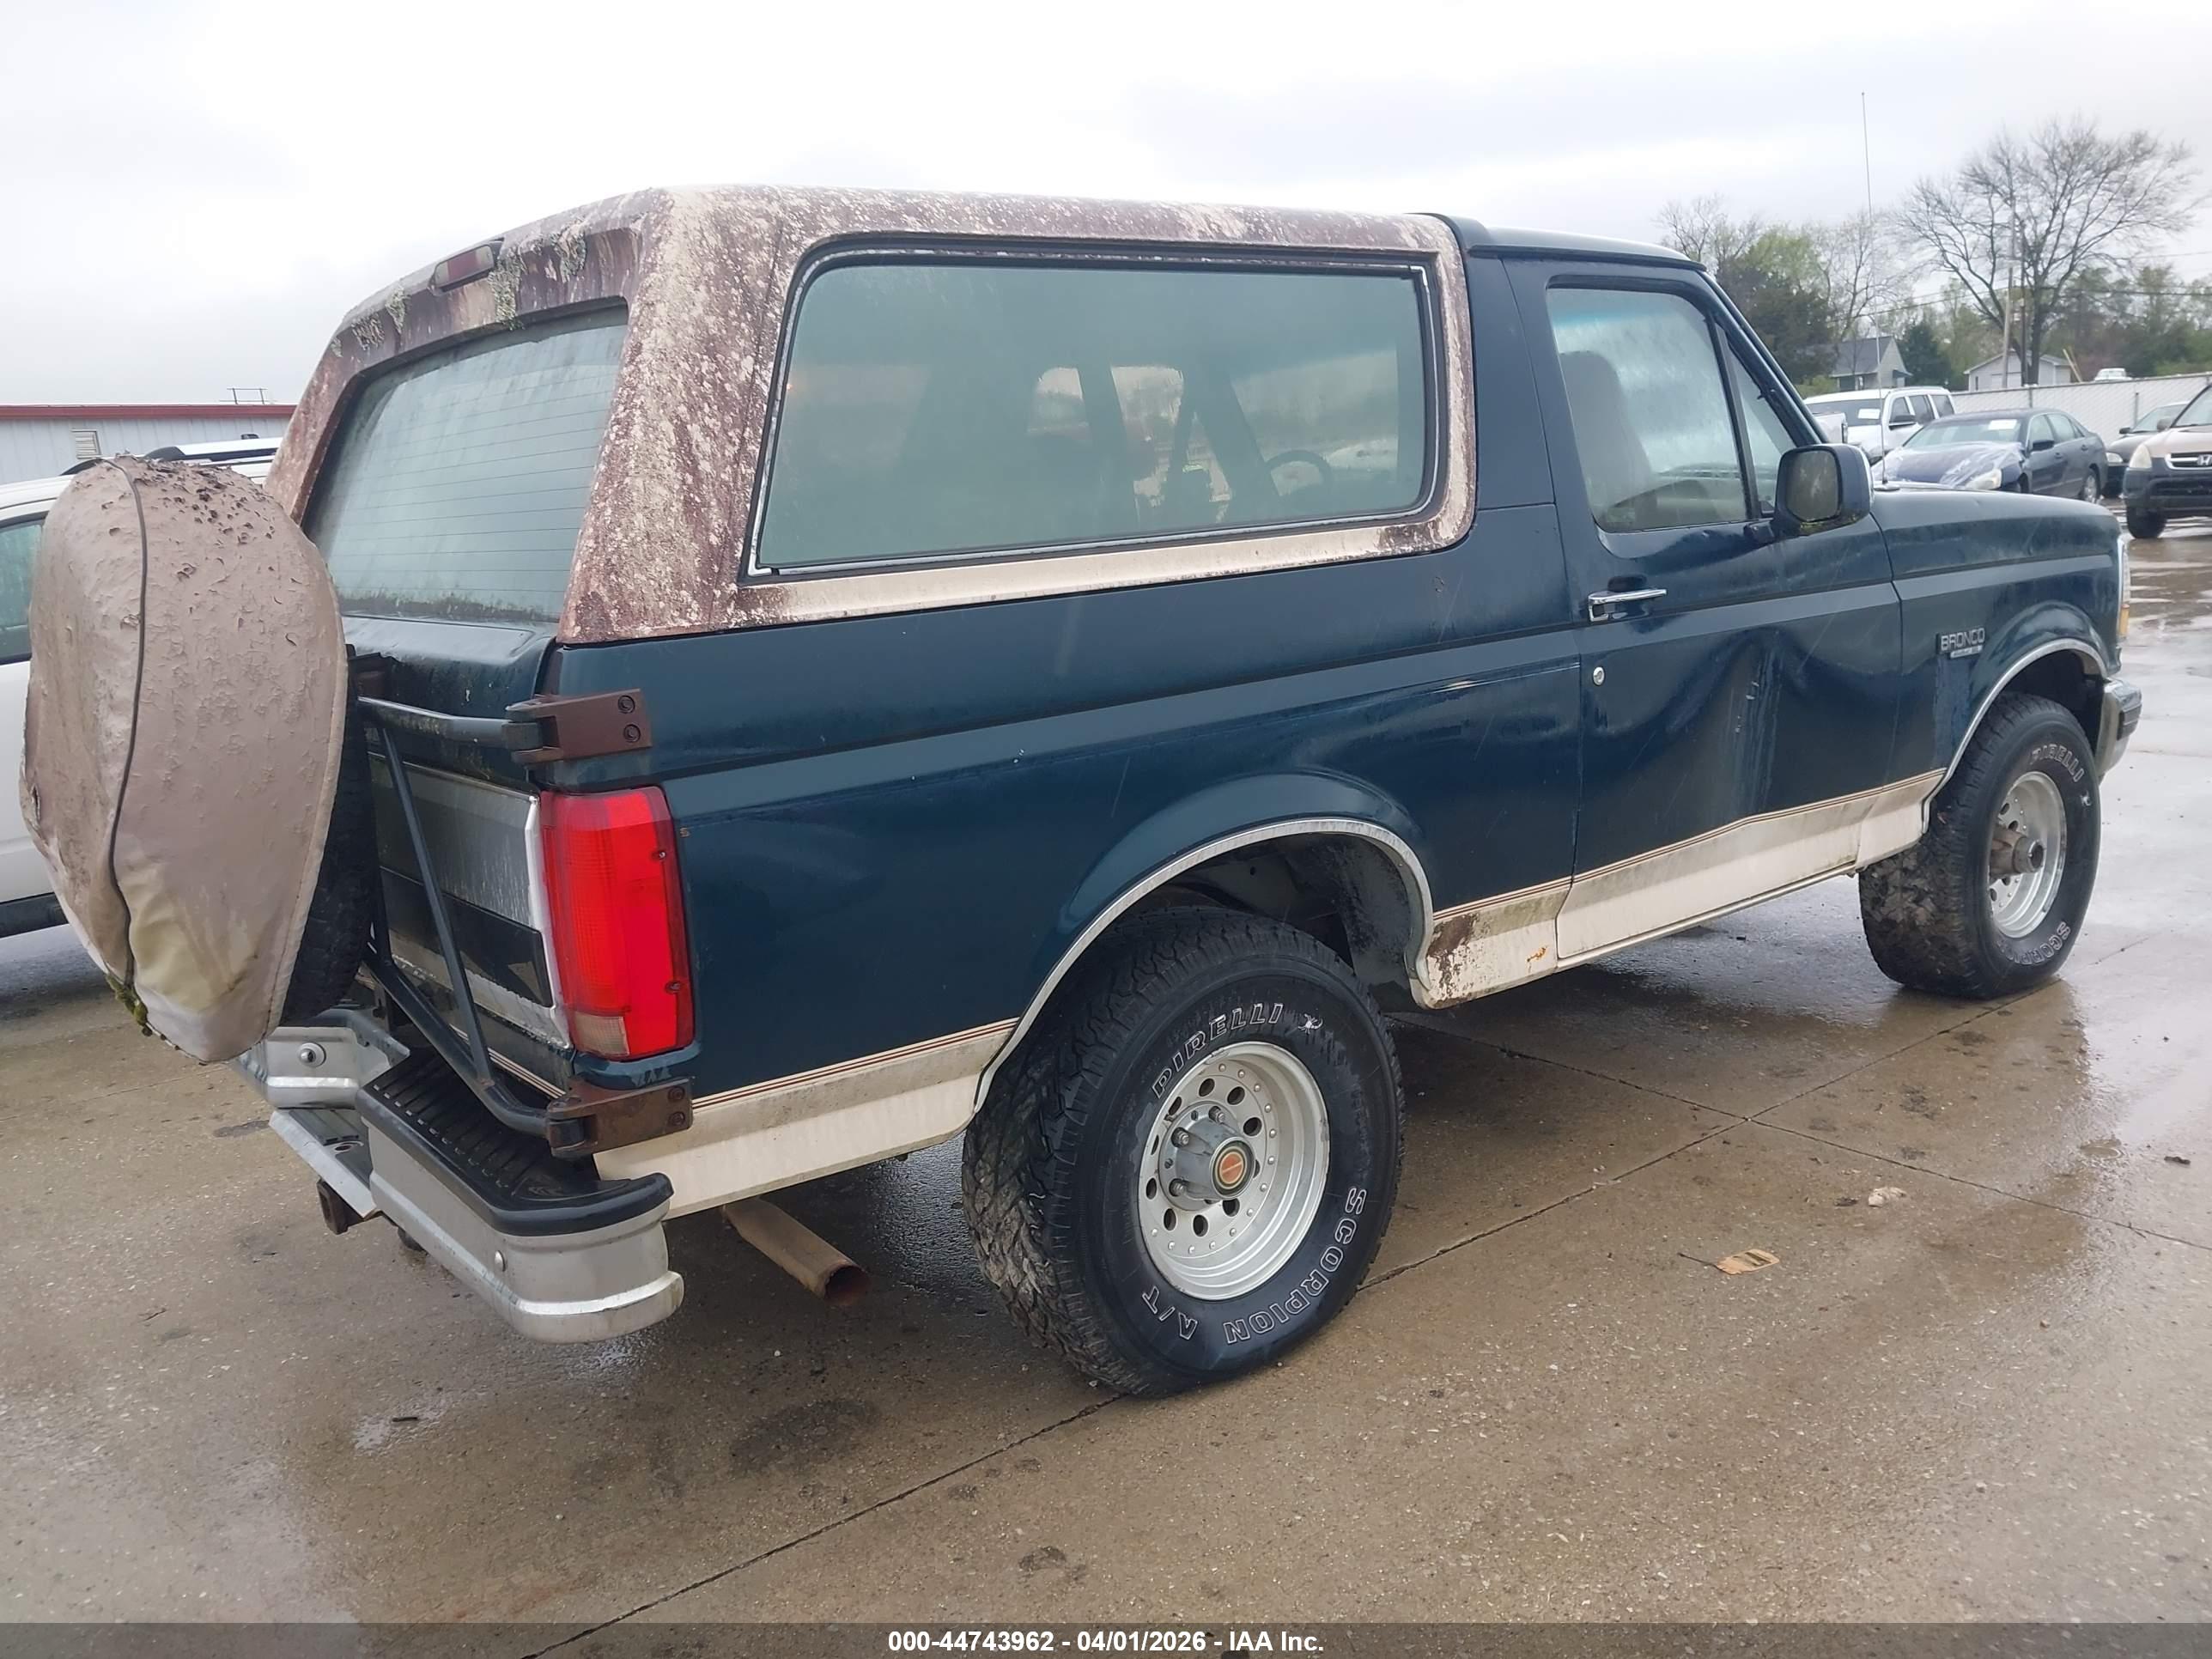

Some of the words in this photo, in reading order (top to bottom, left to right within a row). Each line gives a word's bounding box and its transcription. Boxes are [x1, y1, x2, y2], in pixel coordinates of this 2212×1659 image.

[1941, 628, 1985, 651] BRONCO
[1152, 1003, 1284, 1098] PIRELLI
[1223, 1187, 1368, 1344] SCORPION
[1142, 1285, 1198, 1340] A/T
